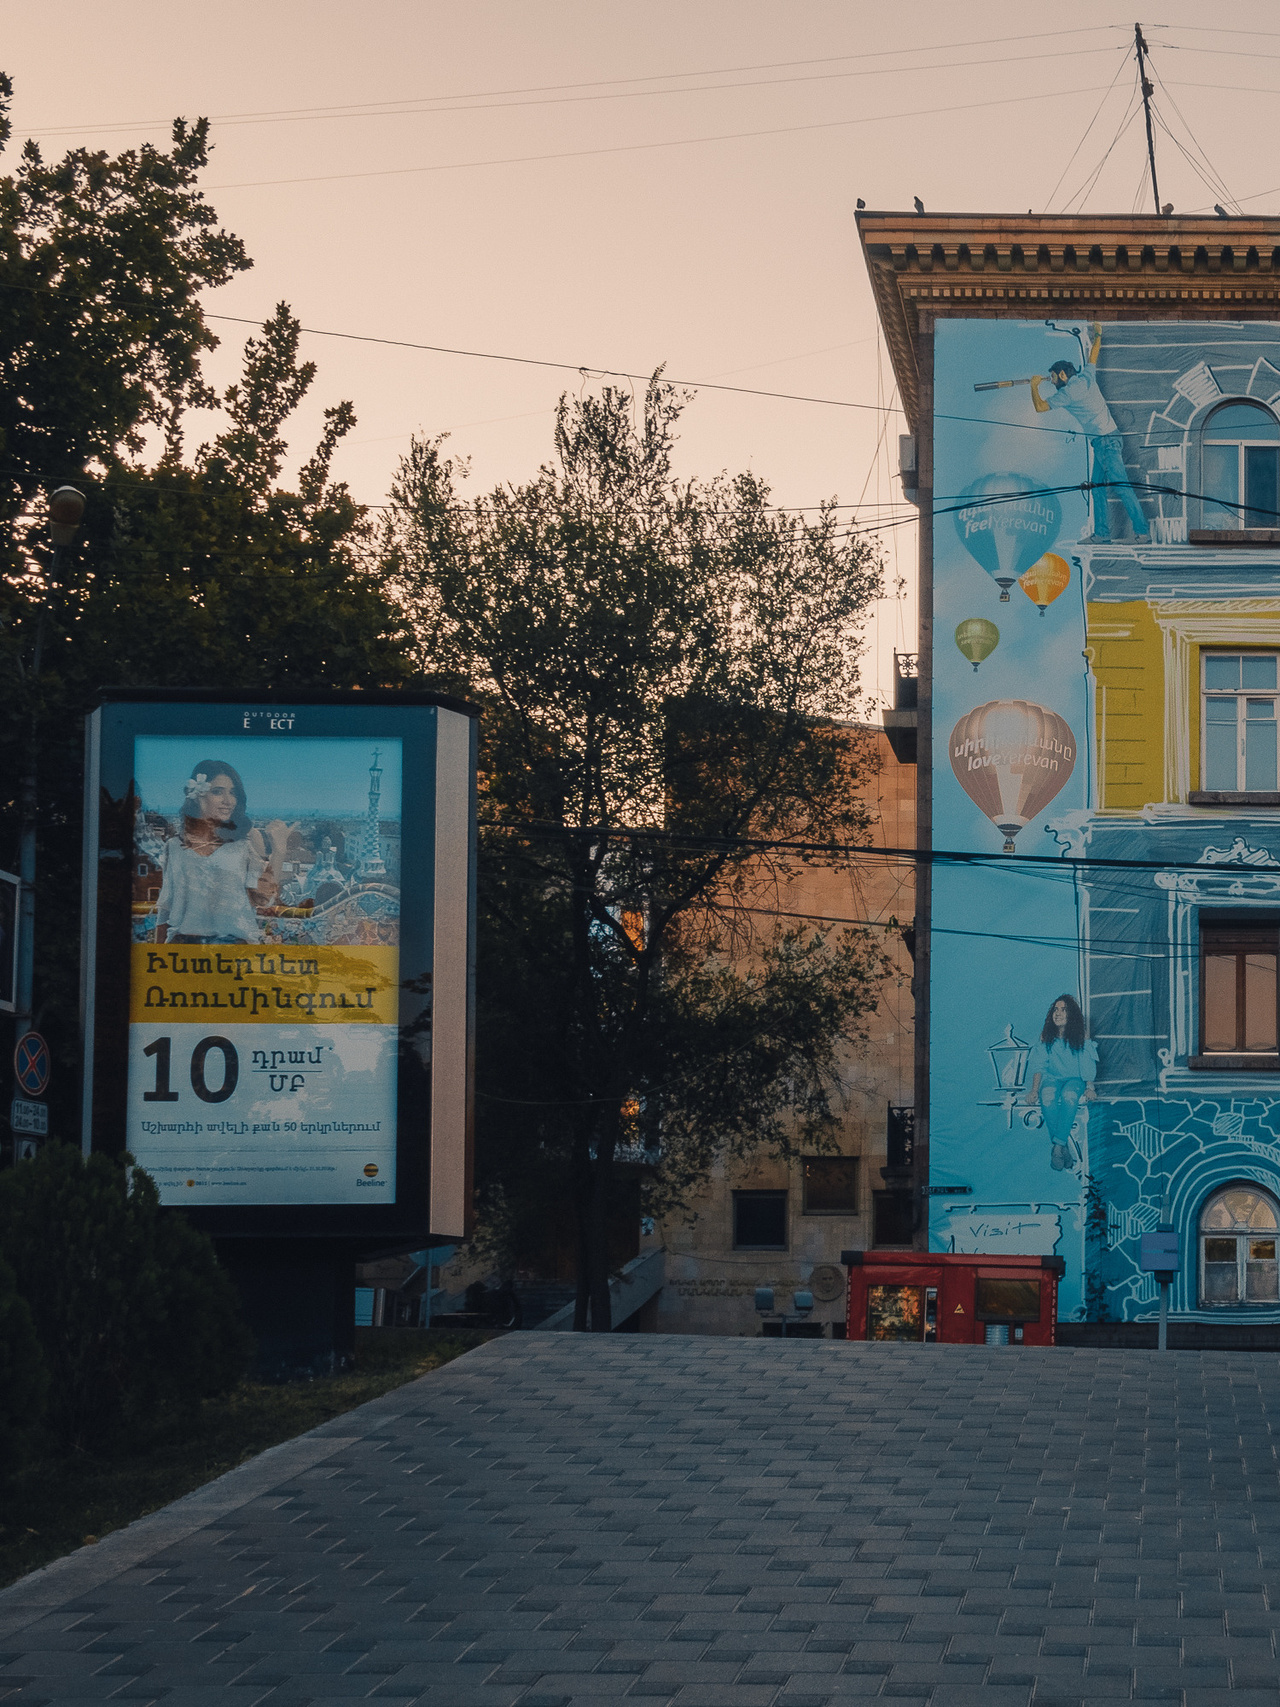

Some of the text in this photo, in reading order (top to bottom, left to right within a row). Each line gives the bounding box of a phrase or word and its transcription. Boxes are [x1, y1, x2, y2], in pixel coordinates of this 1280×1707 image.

[146, 952, 319, 980] Ինտերնետ
[144, 985, 376, 1015] Ռոումինգում
[143, 1035, 239, 1104] 10
[269, 1074, 305, 1092] ՄԲ
[141, 1121, 381, 1135] Աշխարհի ավելի քան 50 երկրներում
[356, 1178, 385, 1187] Beeline
[969, 1221, 1041, 1238] Visit
